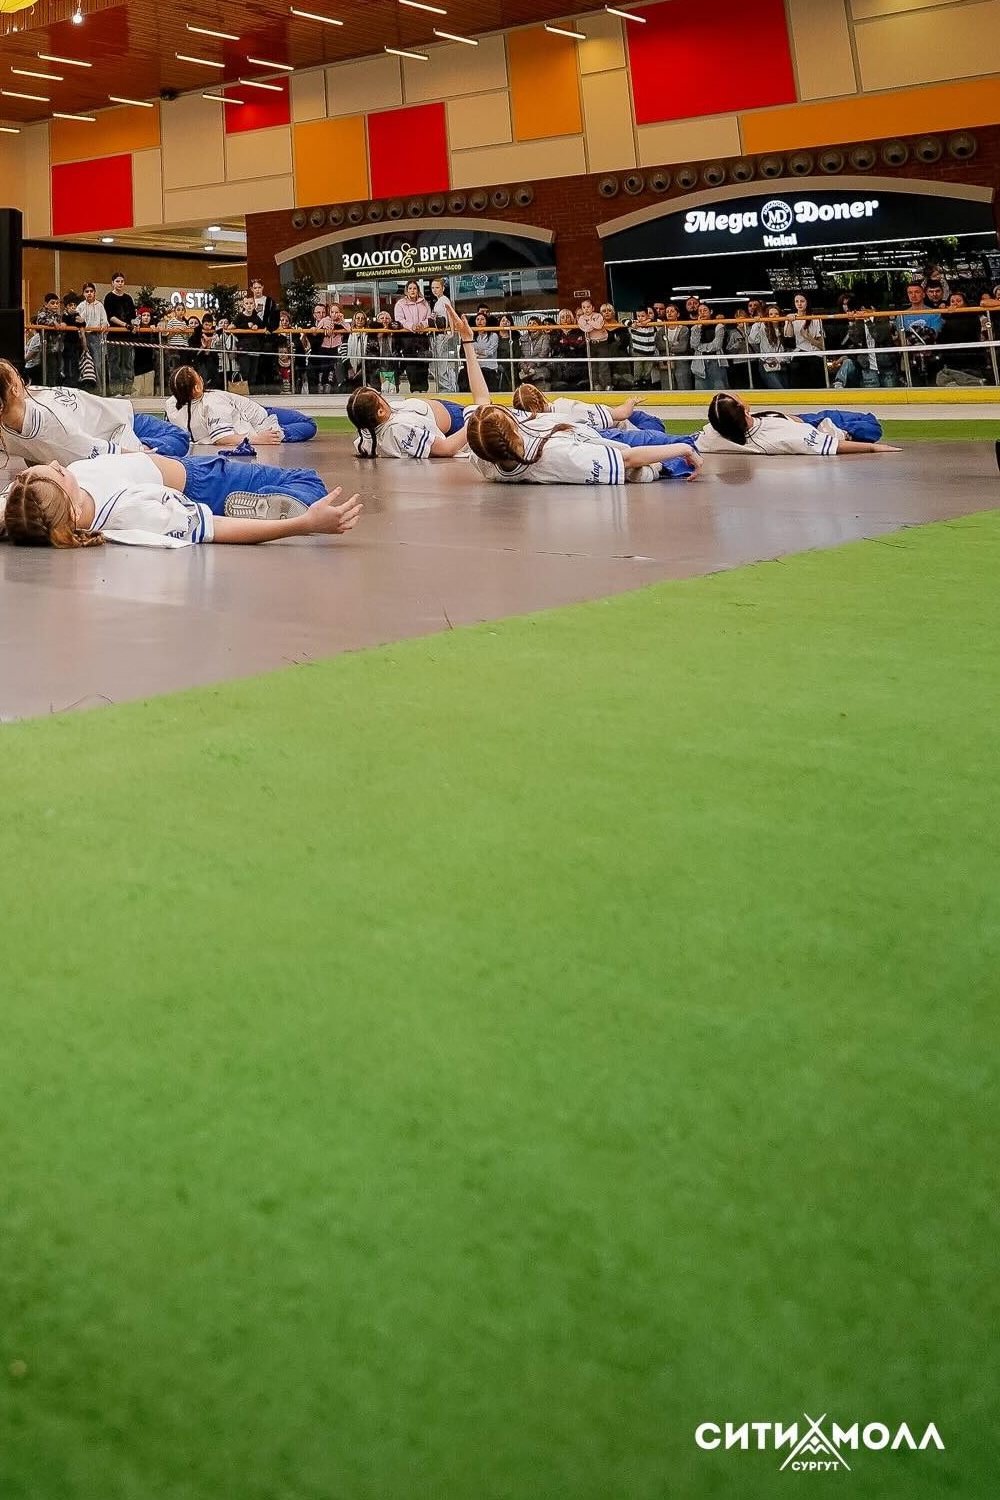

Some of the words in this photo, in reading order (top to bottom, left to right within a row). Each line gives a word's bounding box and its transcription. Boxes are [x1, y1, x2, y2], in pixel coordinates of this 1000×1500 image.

[684, 211, 758, 234] Mega
[794, 199, 879, 223] Doner
[763, 233, 798, 247] Halal
[342, 249, 402, 267] ЗОЛОТО
[420, 242, 473, 261] ВРЕМЯ
[417, 265, 441, 273] МАГАЗИН
